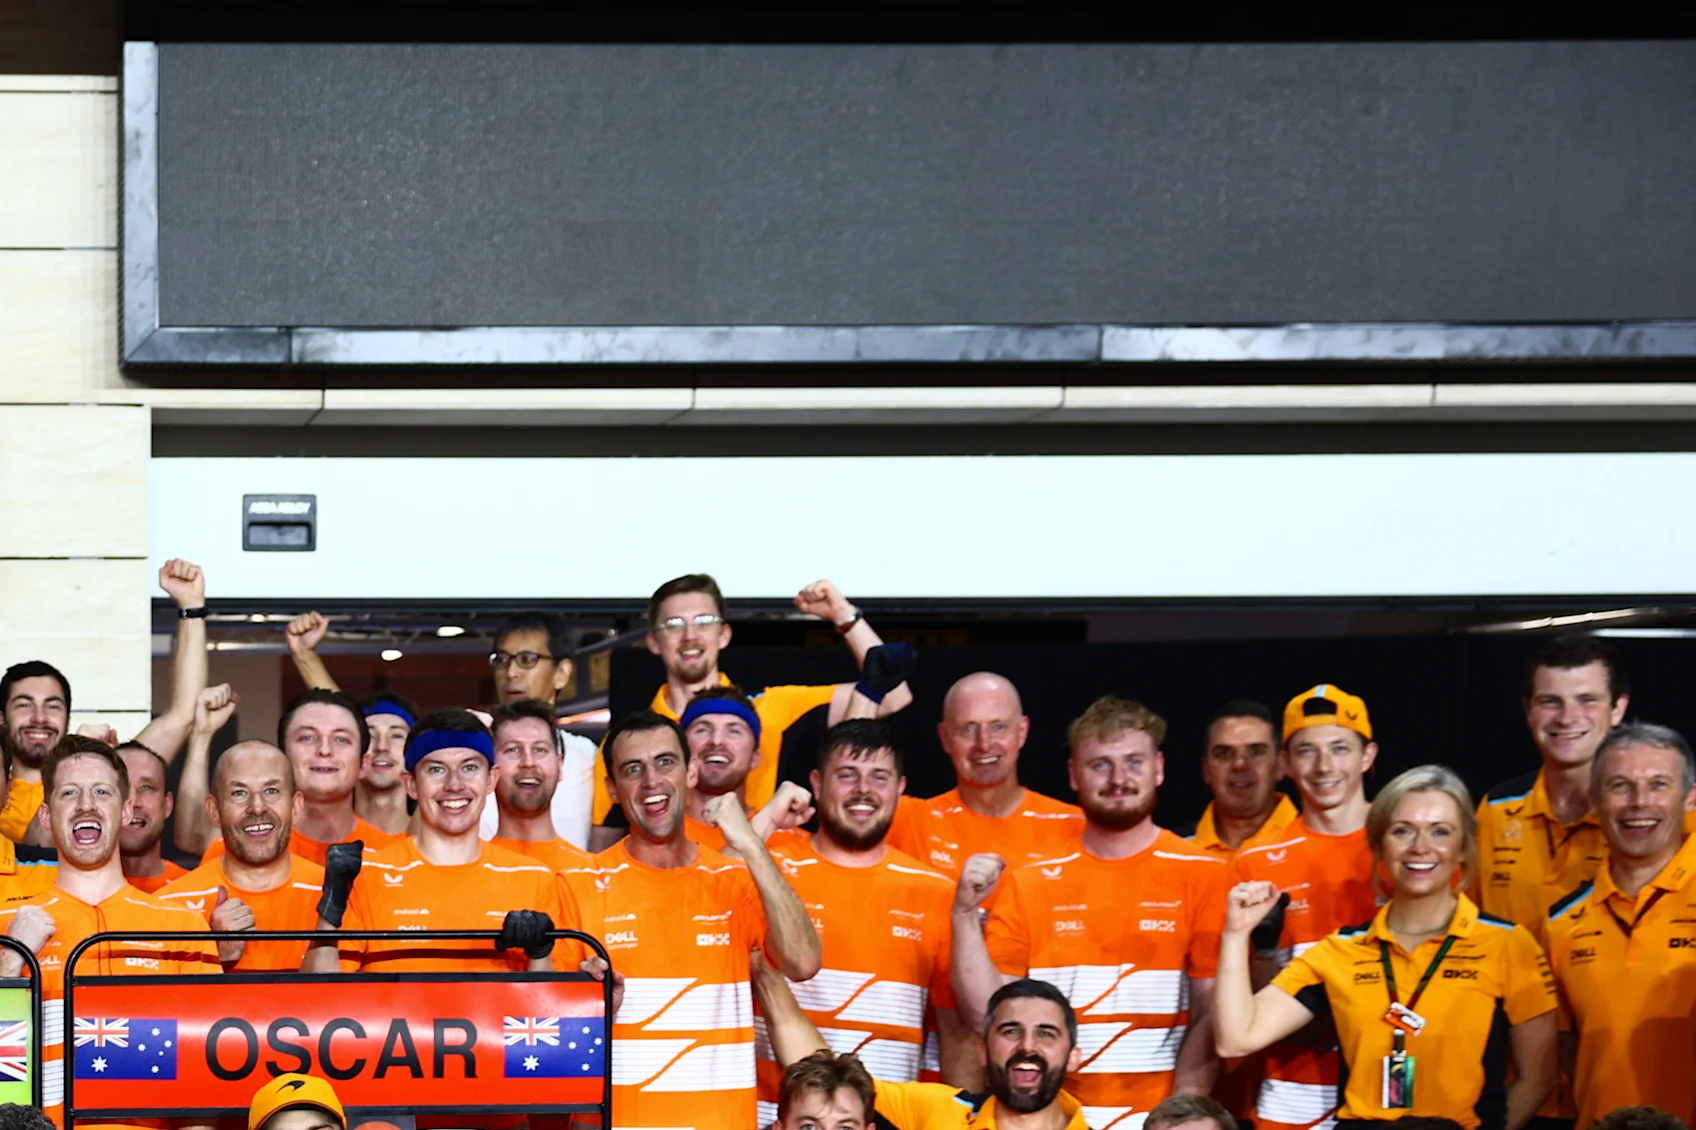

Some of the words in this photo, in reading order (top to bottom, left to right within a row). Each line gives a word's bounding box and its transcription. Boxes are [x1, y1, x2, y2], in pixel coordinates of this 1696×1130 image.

[605, 931, 638, 943] DELL
[697, 933, 731, 946] OKX
[205, 1017, 477, 1080] OSCAR
